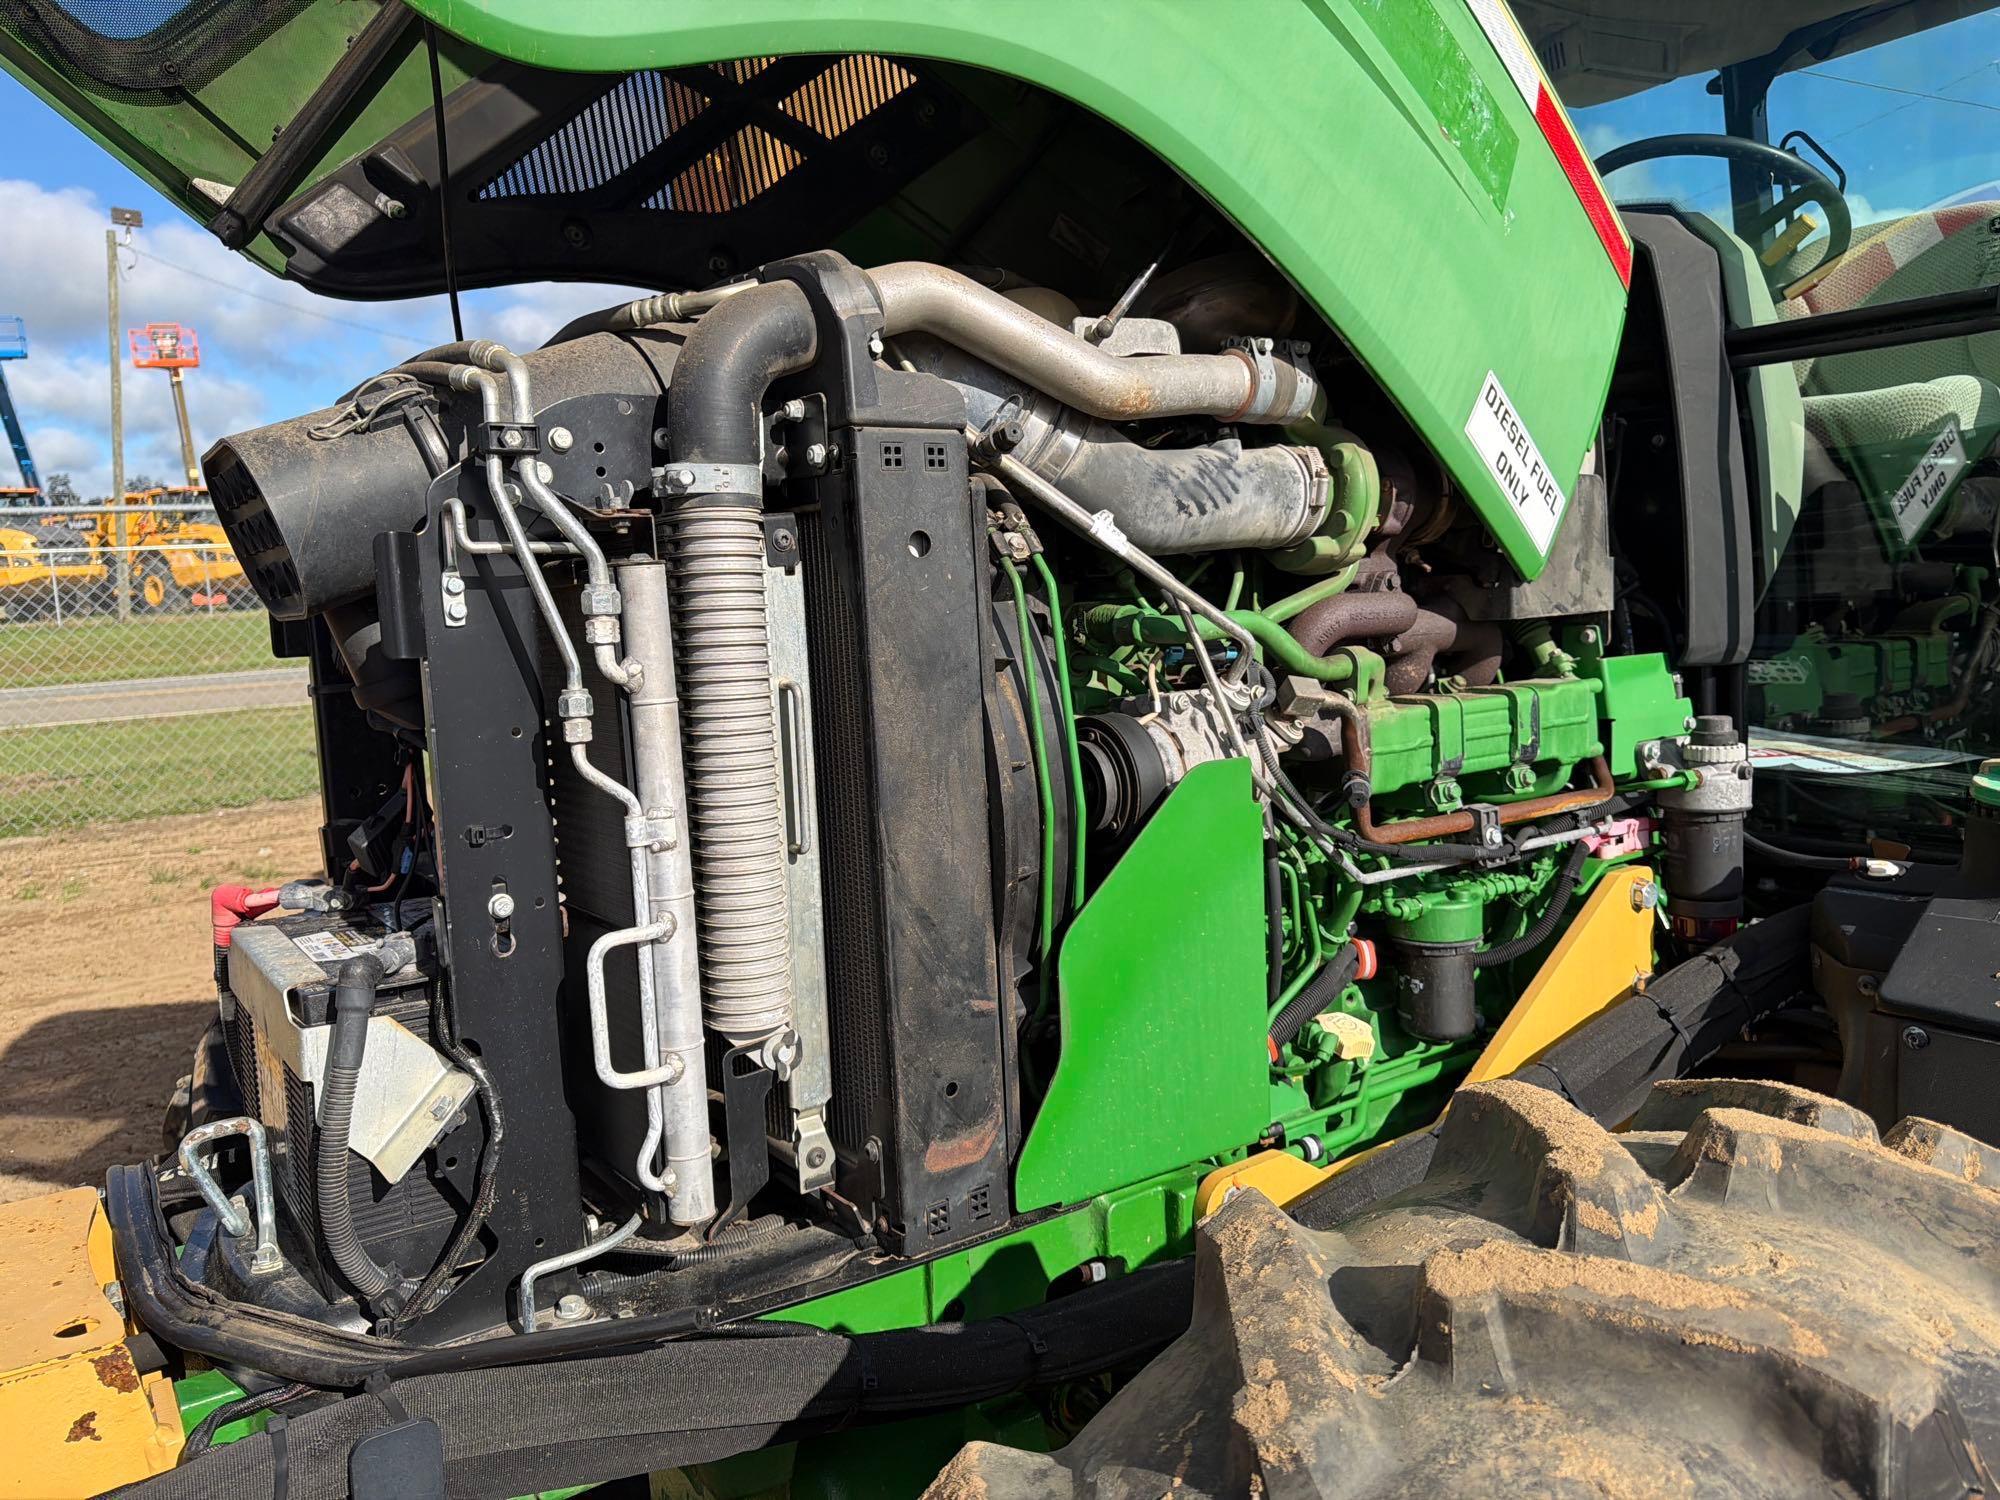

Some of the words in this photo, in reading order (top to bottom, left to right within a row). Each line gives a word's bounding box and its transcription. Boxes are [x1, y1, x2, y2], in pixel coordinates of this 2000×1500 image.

[1484, 384, 1530, 468] DIESEL
[1530, 460, 1558, 516] FUEL
[1496, 451, 1530, 507] ONLY
